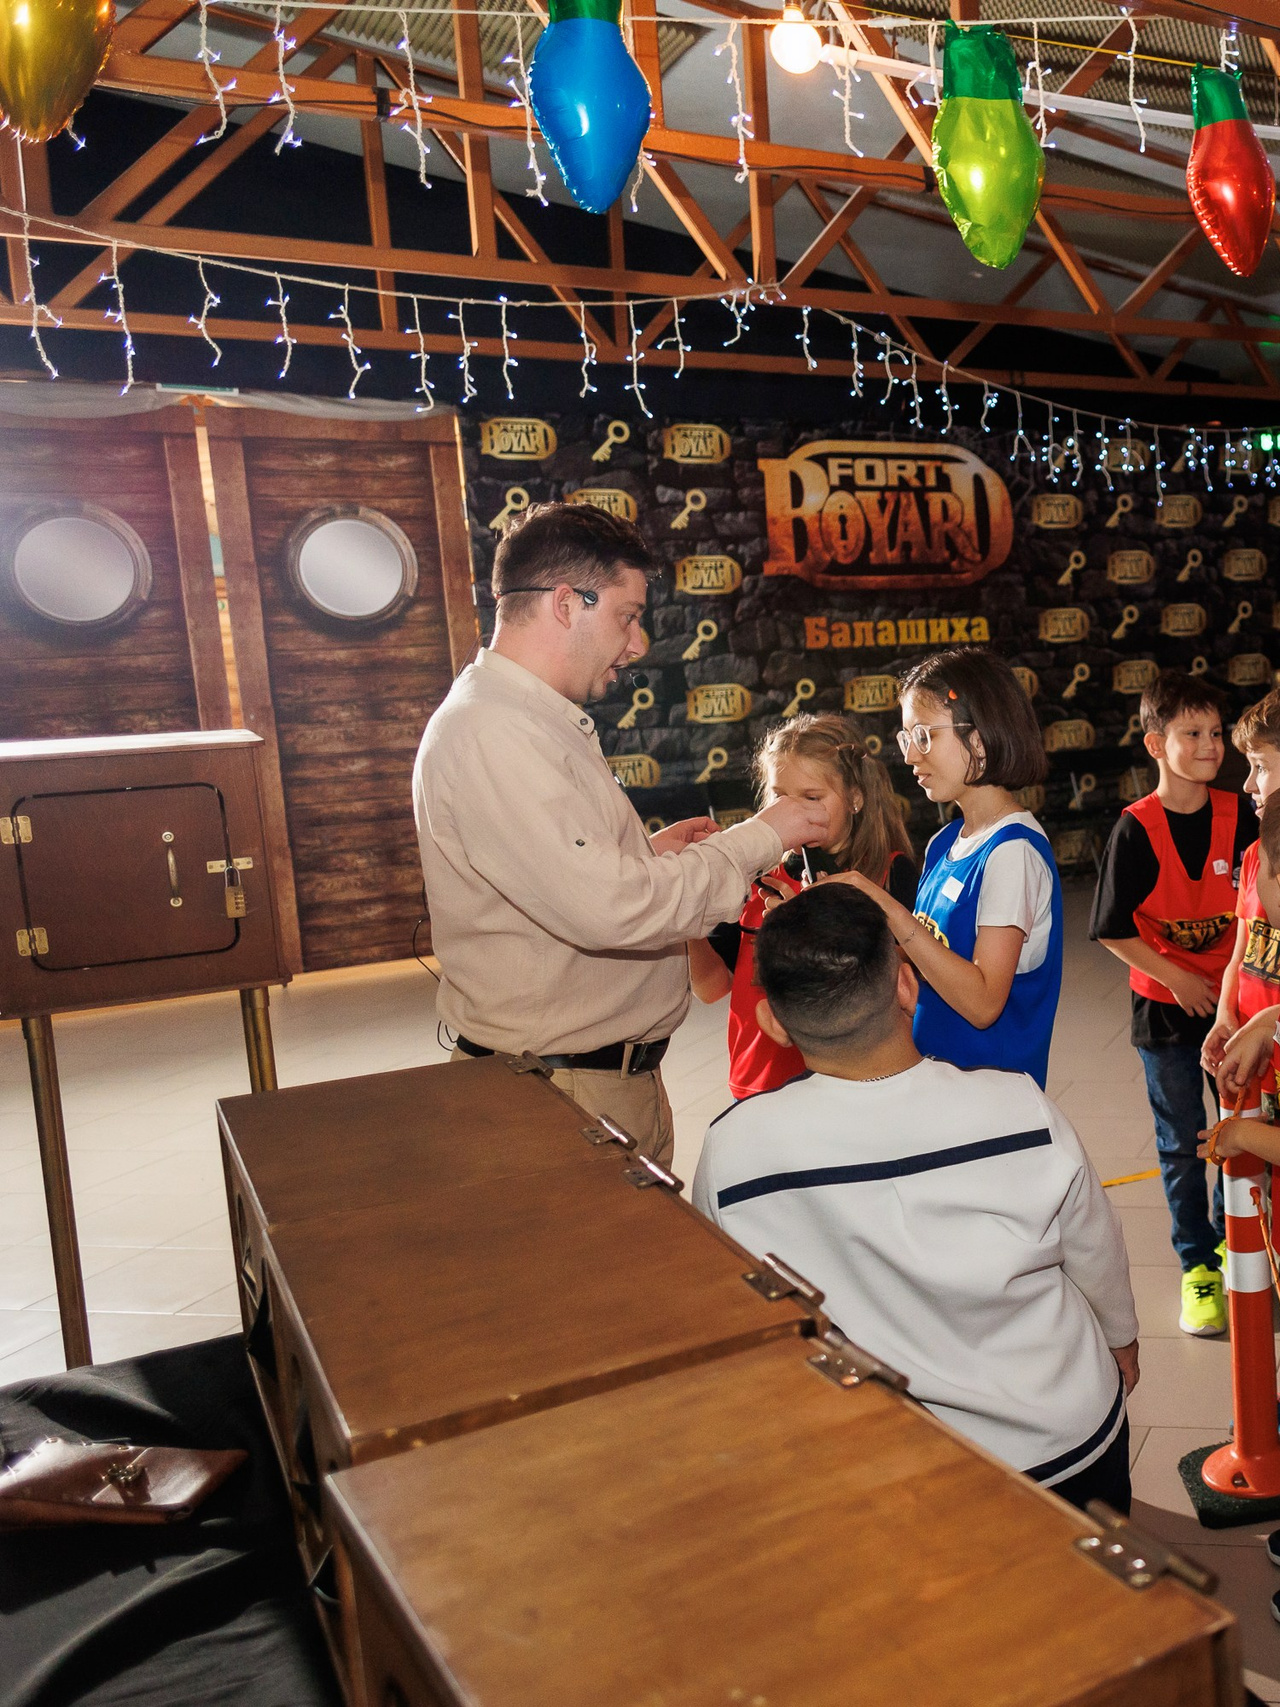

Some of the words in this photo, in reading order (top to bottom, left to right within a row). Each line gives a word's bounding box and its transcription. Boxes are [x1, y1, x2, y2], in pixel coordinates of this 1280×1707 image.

[479, 420, 557, 457] BOYARD
[827, 457, 942, 488] FORT
[757, 451, 1014, 583] BOYARD
[804, 616, 990, 649] Балашиха
[1183, 917, 1221, 929] FORT
